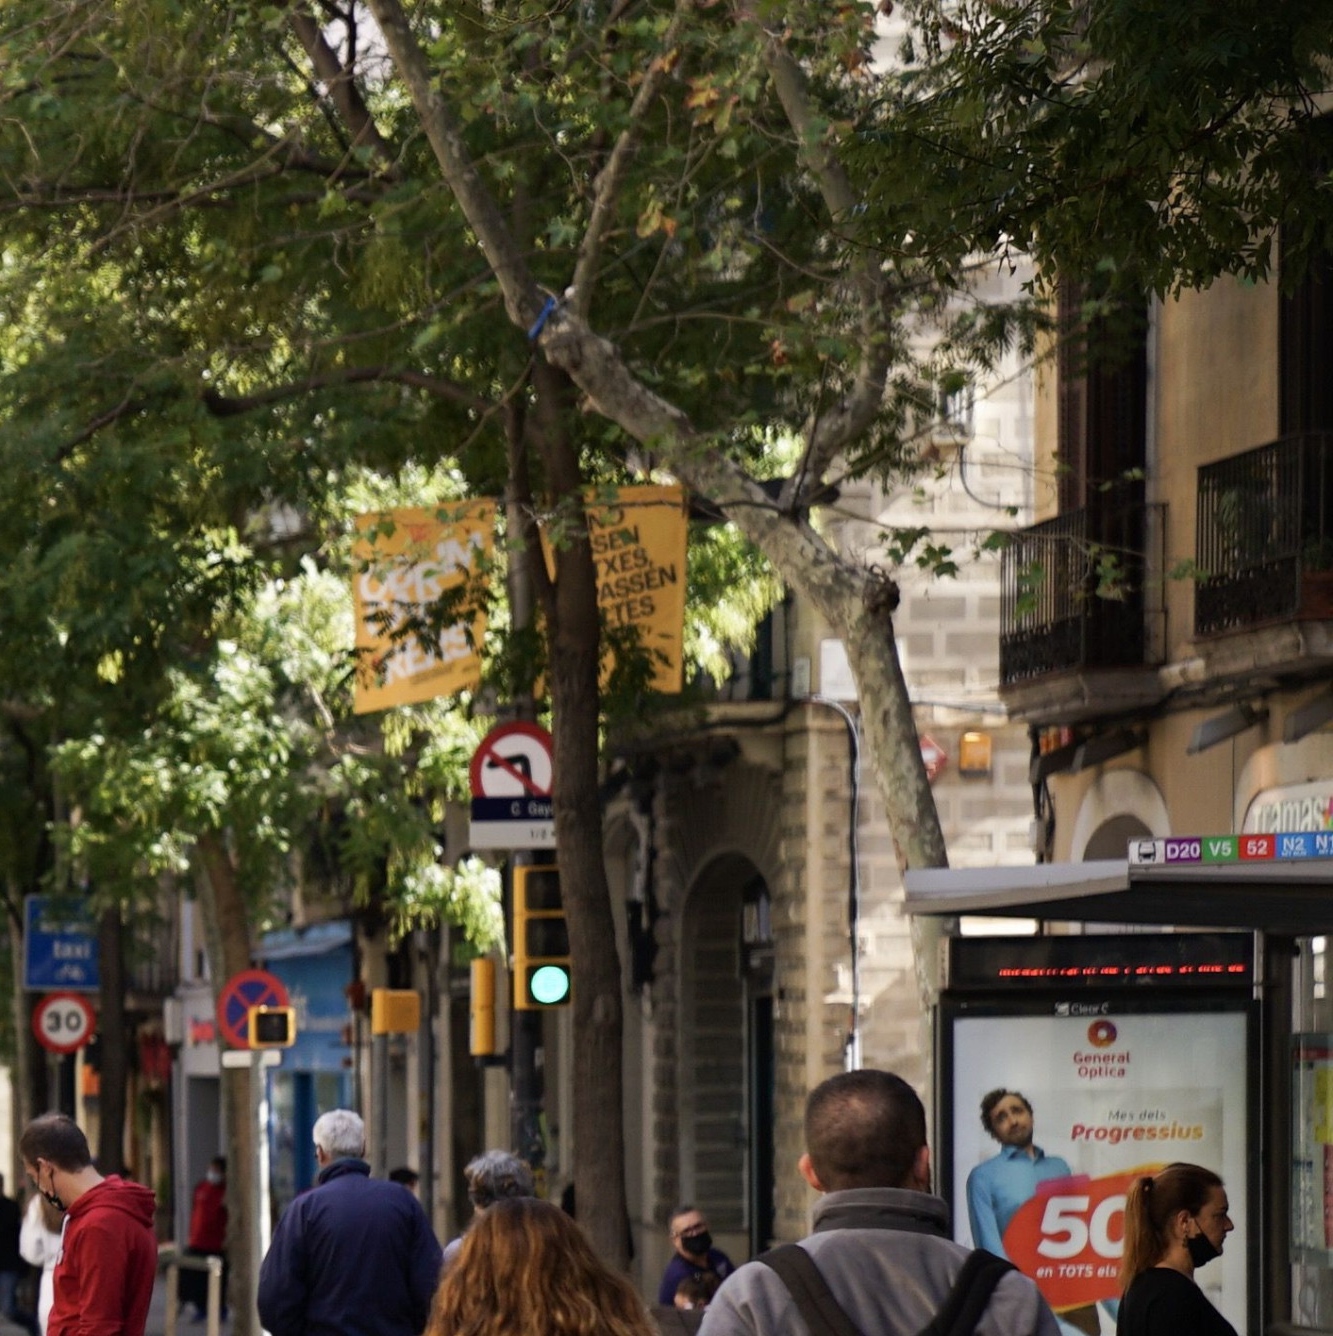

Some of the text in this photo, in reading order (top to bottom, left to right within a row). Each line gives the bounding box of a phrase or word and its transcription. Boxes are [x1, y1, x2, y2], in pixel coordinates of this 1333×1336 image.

[600, 563, 677, 602] ASSEN
[1166, 843, 1201, 860] D20
[1209, 840, 1233, 858] V5
[1246, 840, 1269, 856] 52
[1283, 836, 1305, 851] N2
[46, 1012, 83, 1033] 30
[1073, 1051, 1130, 1064] General
[1077, 1065, 1126, 1080] Optica
[1138, 1109, 1167, 1121] dels
[1071, 1121, 1204, 1145] Progressius
[1036, 1263, 1118, 1278] en TOTS els
